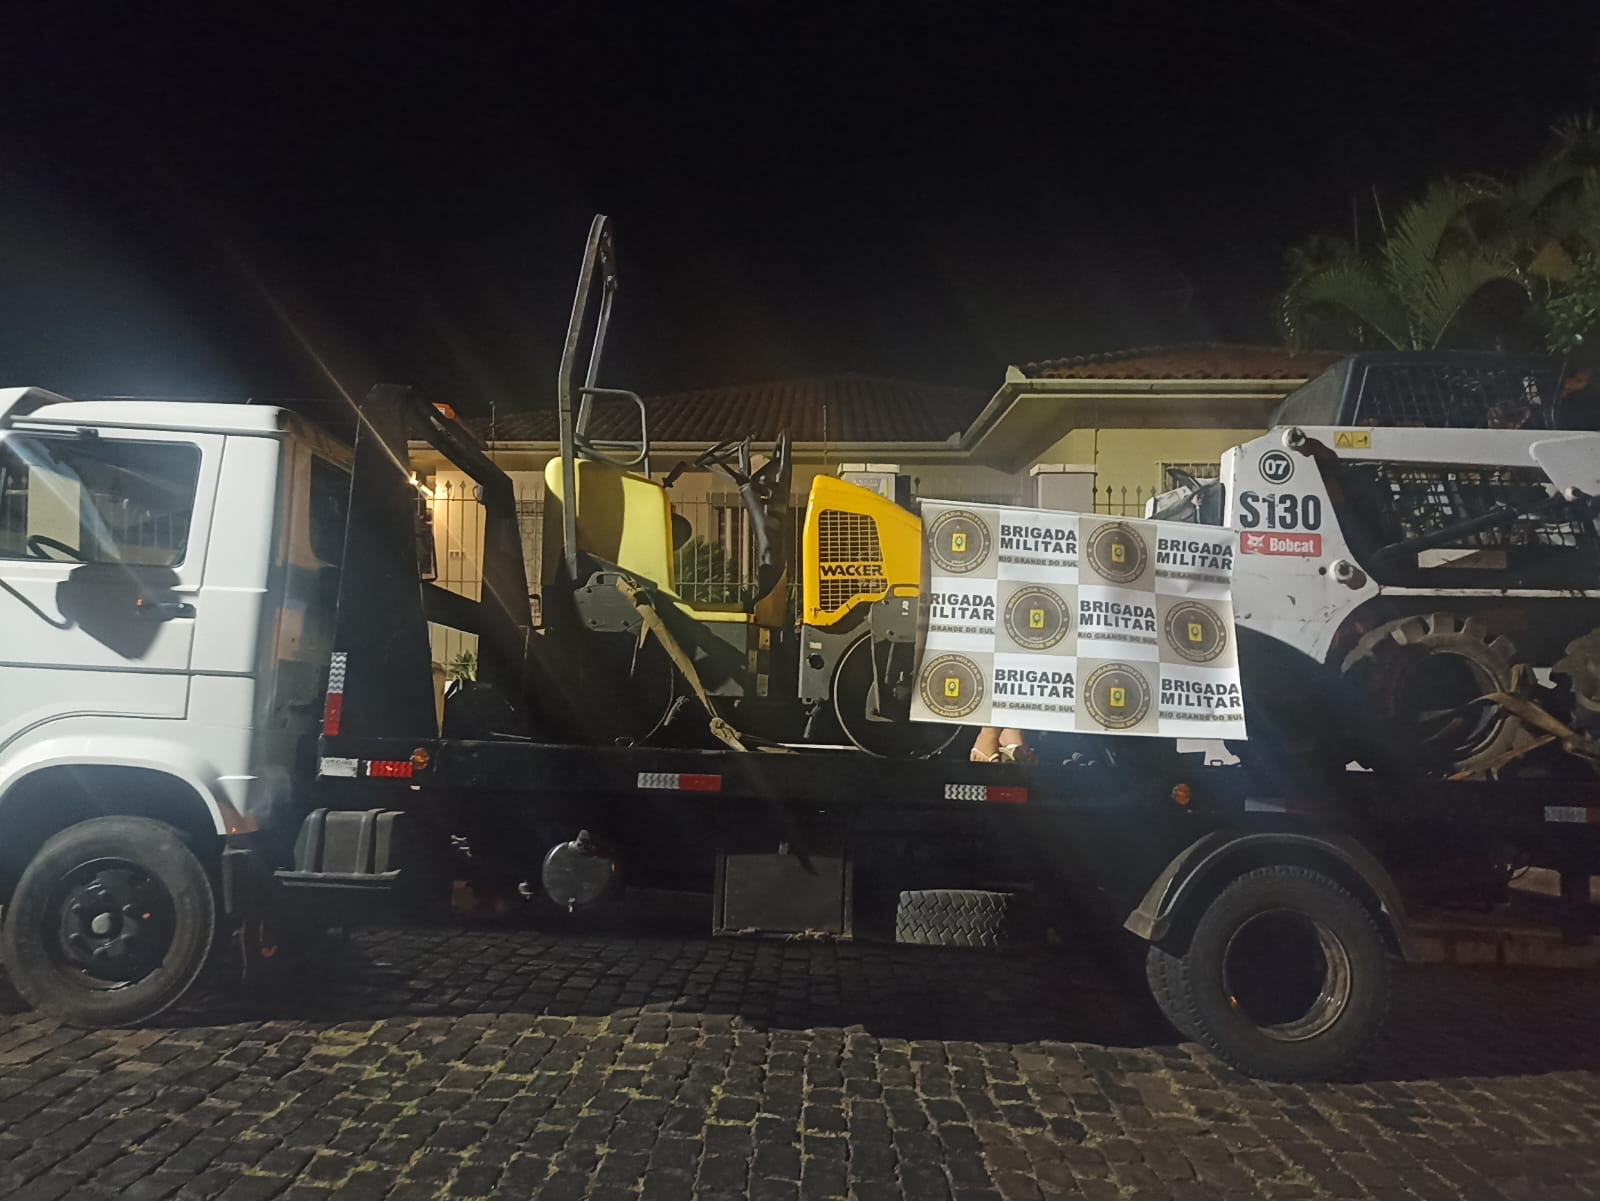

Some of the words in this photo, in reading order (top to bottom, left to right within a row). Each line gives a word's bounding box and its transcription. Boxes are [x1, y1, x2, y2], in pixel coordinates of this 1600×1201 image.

[1265, 459, 1287, 475] 07
[1240, 491, 1321, 530] S130
[1001, 525, 1077, 541] BRIGADA
[1000, 537, 1077, 554] MILITAR
[1158, 538, 1233, 557] BRIGADA
[1270, 537, 1314, 553] Bobcat
[1014, 556, 1047, 566] GRANDE
[1048, 558, 1060, 566] DO
[1062, 559, 1078, 567] SUL
[1157, 552, 1232, 570] MILITAR
[819, 564, 883, 576] WACKER
[1080, 600, 1155, 619] BRIGADA
[931, 625, 963, 633] GRANDE
[1080, 613, 1156, 632] MILITAR
[1078, 631, 1092, 639] RIO
[1095, 632, 1128, 641] GRANDE
[995, 669, 1074, 685] BRIGADA
[994, 682, 1074, 698] MILITAR
[1161, 678, 1239, 695] BRIGADA
[1009, 702, 1042, 711] GRANDE
[1161, 692, 1241, 708] MILITAR
[1176, 713, 1211, 721] GRANDE
